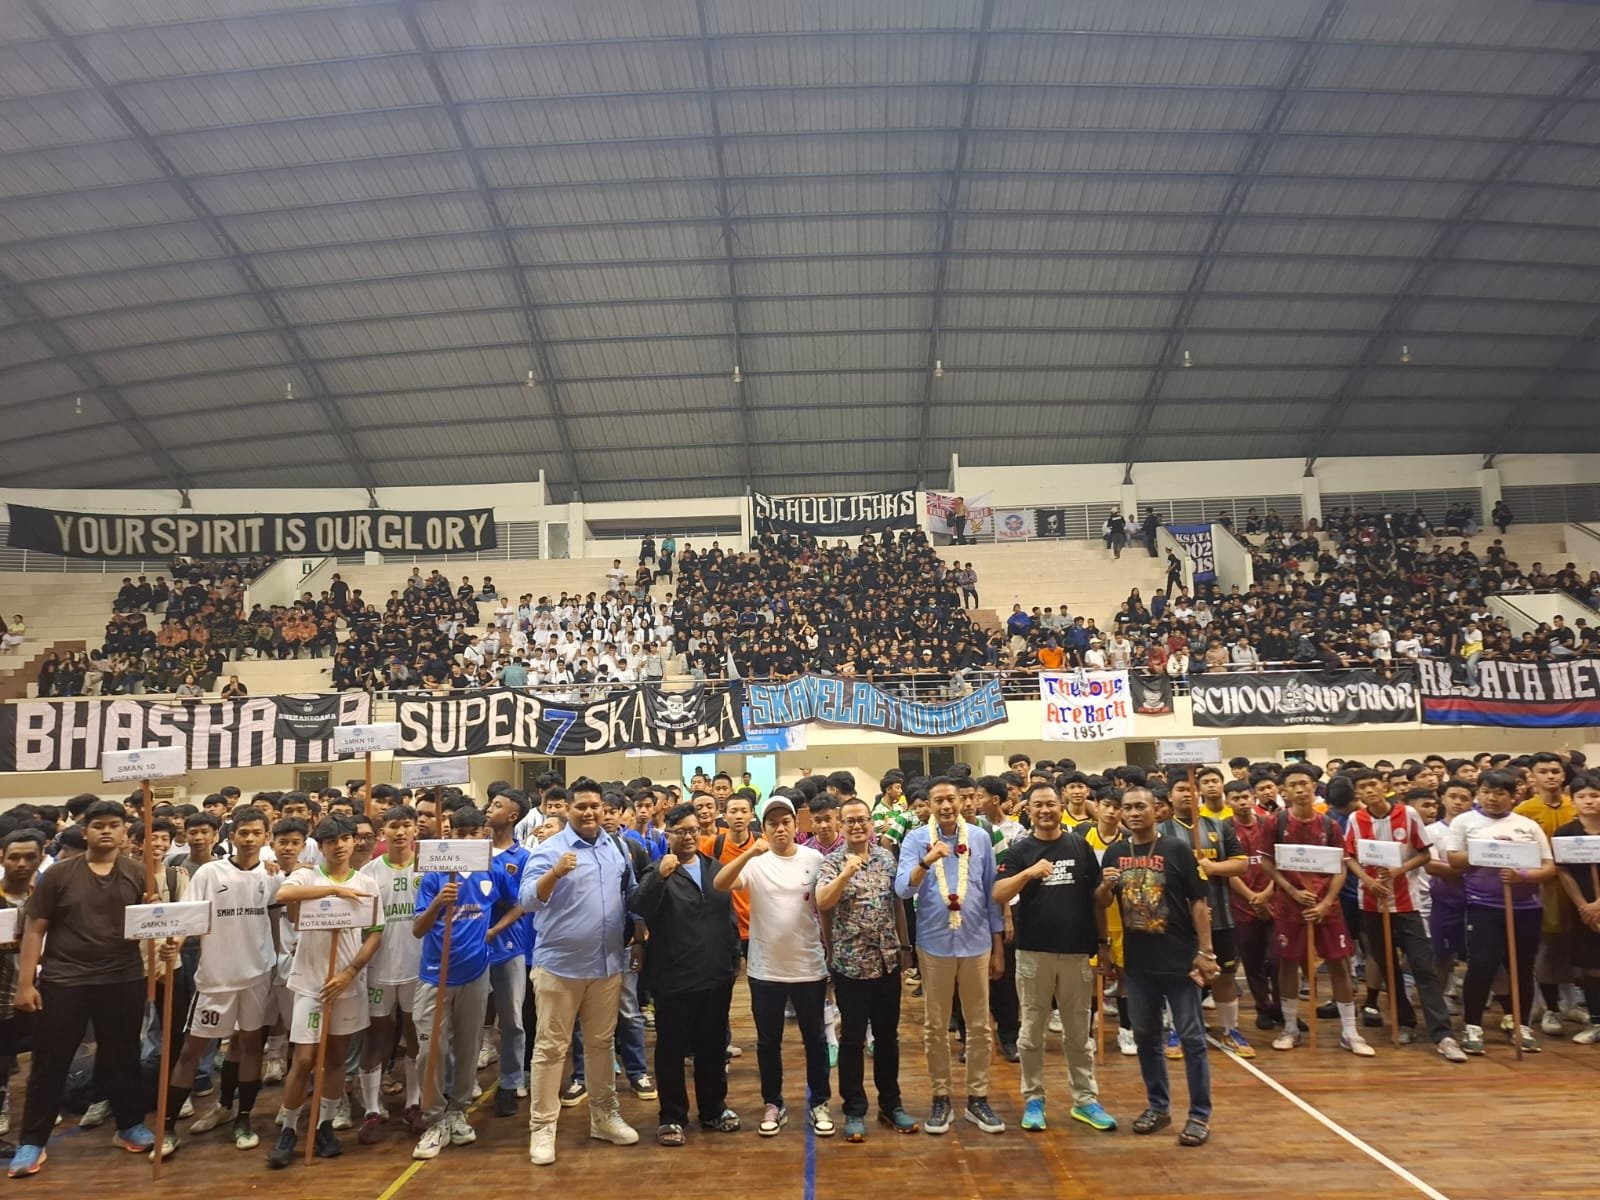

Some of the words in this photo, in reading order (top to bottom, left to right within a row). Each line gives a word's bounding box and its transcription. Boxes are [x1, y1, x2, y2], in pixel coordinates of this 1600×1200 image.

[54, 515, 146, 556] YOUR
[150, 517, 265, 554] SPIRIT
[274, 517, 307, 552] IS
[315, 514, 373, 552] OUR
[377, 512, 489, 551] GLORY
[1547, 658, 1600, 700] NE
[1191, 685, 1284, 715] SCHOOL
[1302, 681, 1417, 713] SUPERIOR
[400, 692, 543, 754] SUPER
[542, 707, 579, 755] 7
[118, 764, 143, 773] SMAN
[392, 876, 408, 892] 28
[236, 907, 244, 916] 12
[140, 920, 167, 929] SMKN
[170, 919, 180, 927] 12
[200, 1009, 220, 1026] 30
[307, 1012, 321, 1029] 18
